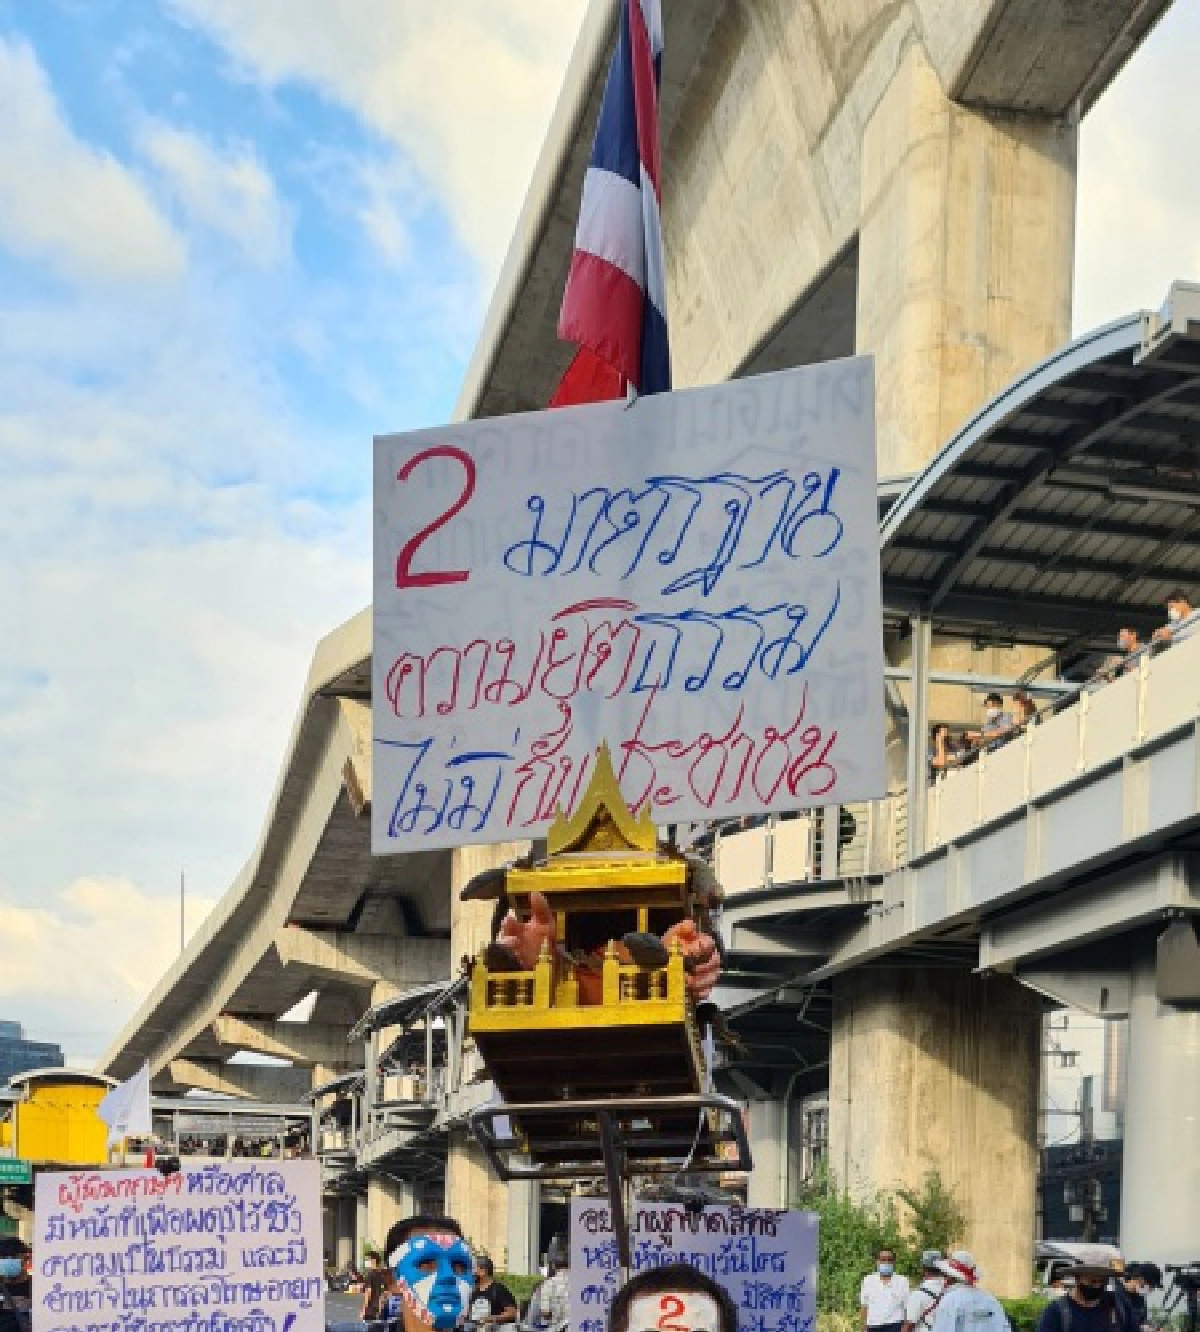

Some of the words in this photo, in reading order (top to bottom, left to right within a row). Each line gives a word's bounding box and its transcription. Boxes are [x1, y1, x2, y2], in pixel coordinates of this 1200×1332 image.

[396, 444, 477, 589] 2
[503, 467, 844, 597] มาตรฐาน
[384, 578, 841, 721] ความยุติธรรม
